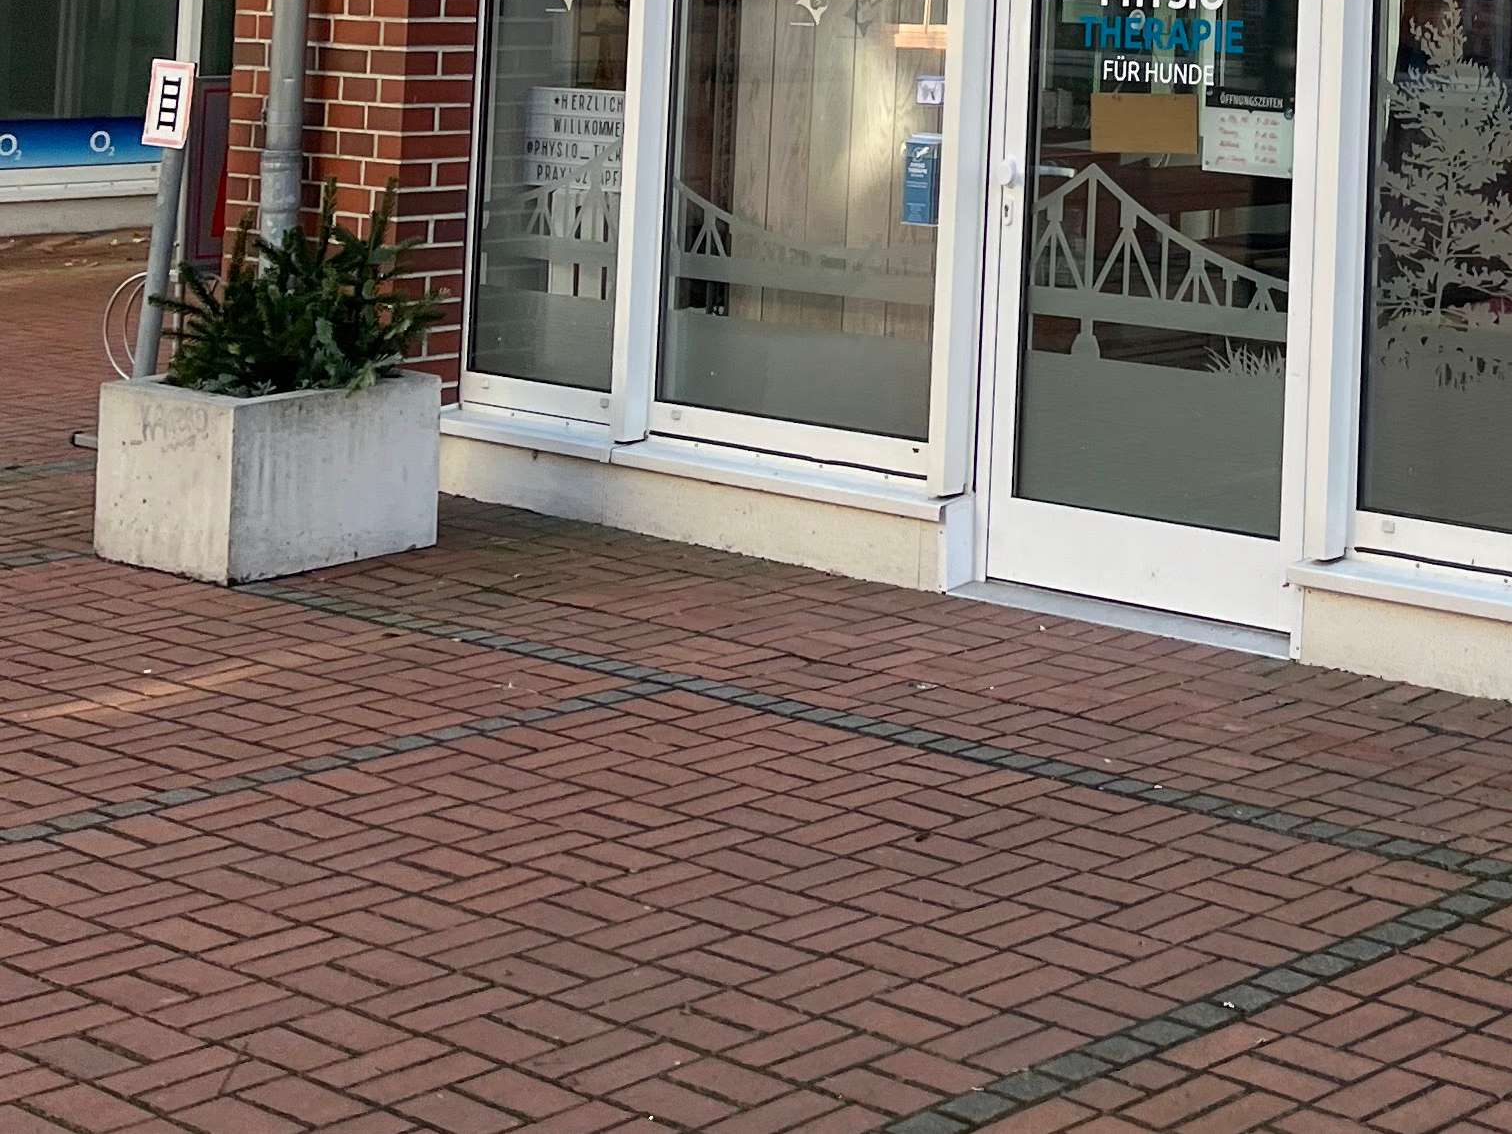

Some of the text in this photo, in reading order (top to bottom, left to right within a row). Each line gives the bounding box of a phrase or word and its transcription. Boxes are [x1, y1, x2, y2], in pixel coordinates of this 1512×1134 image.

[1080, 15, 1245, 55] THERAPIE
[1103, 55, 1215, 86] FÜR HUNDE
[553, 117, 625, 138] WILLKOMME
